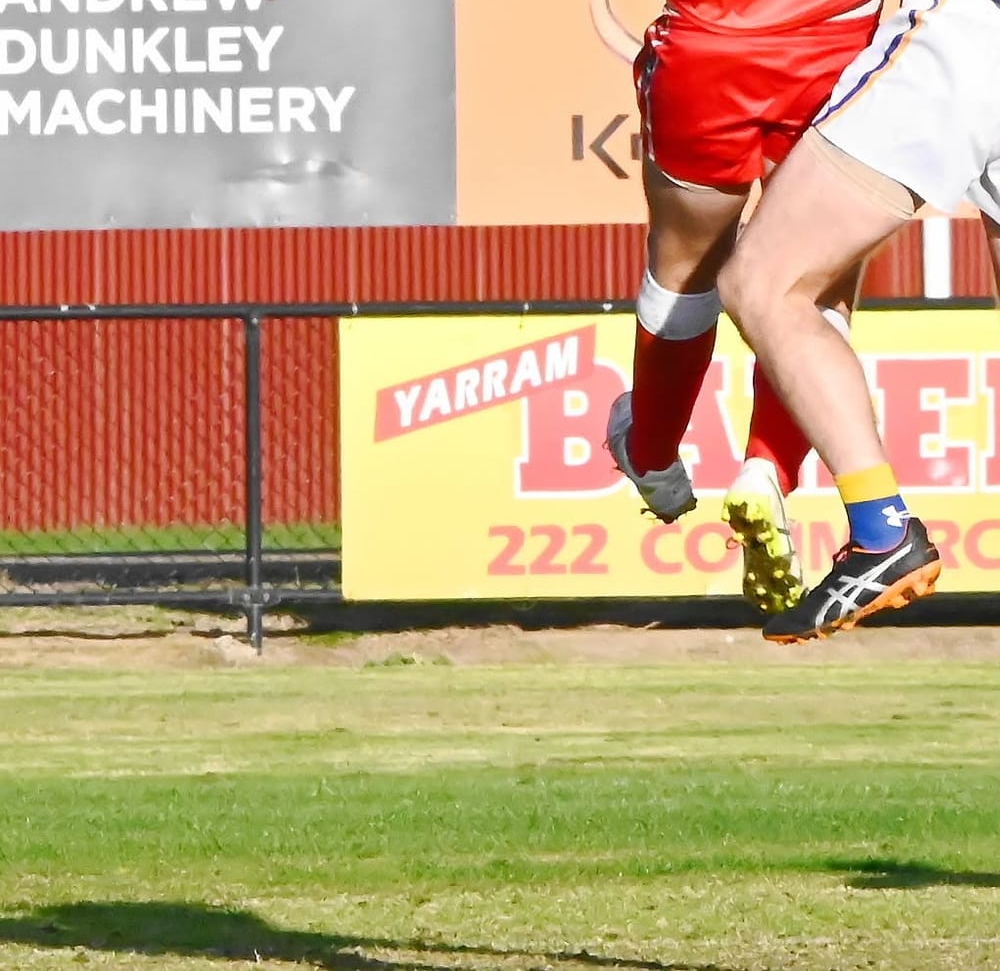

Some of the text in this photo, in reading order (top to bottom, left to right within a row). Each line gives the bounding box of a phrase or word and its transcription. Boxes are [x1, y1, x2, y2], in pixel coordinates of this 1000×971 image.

[0, 26, 284, 75] DUNKLEY
[0, 86, 356, 135] MACHINERY
[394, 335, 581, 427] YARRAM
[487, 523, 609, 576] 222
